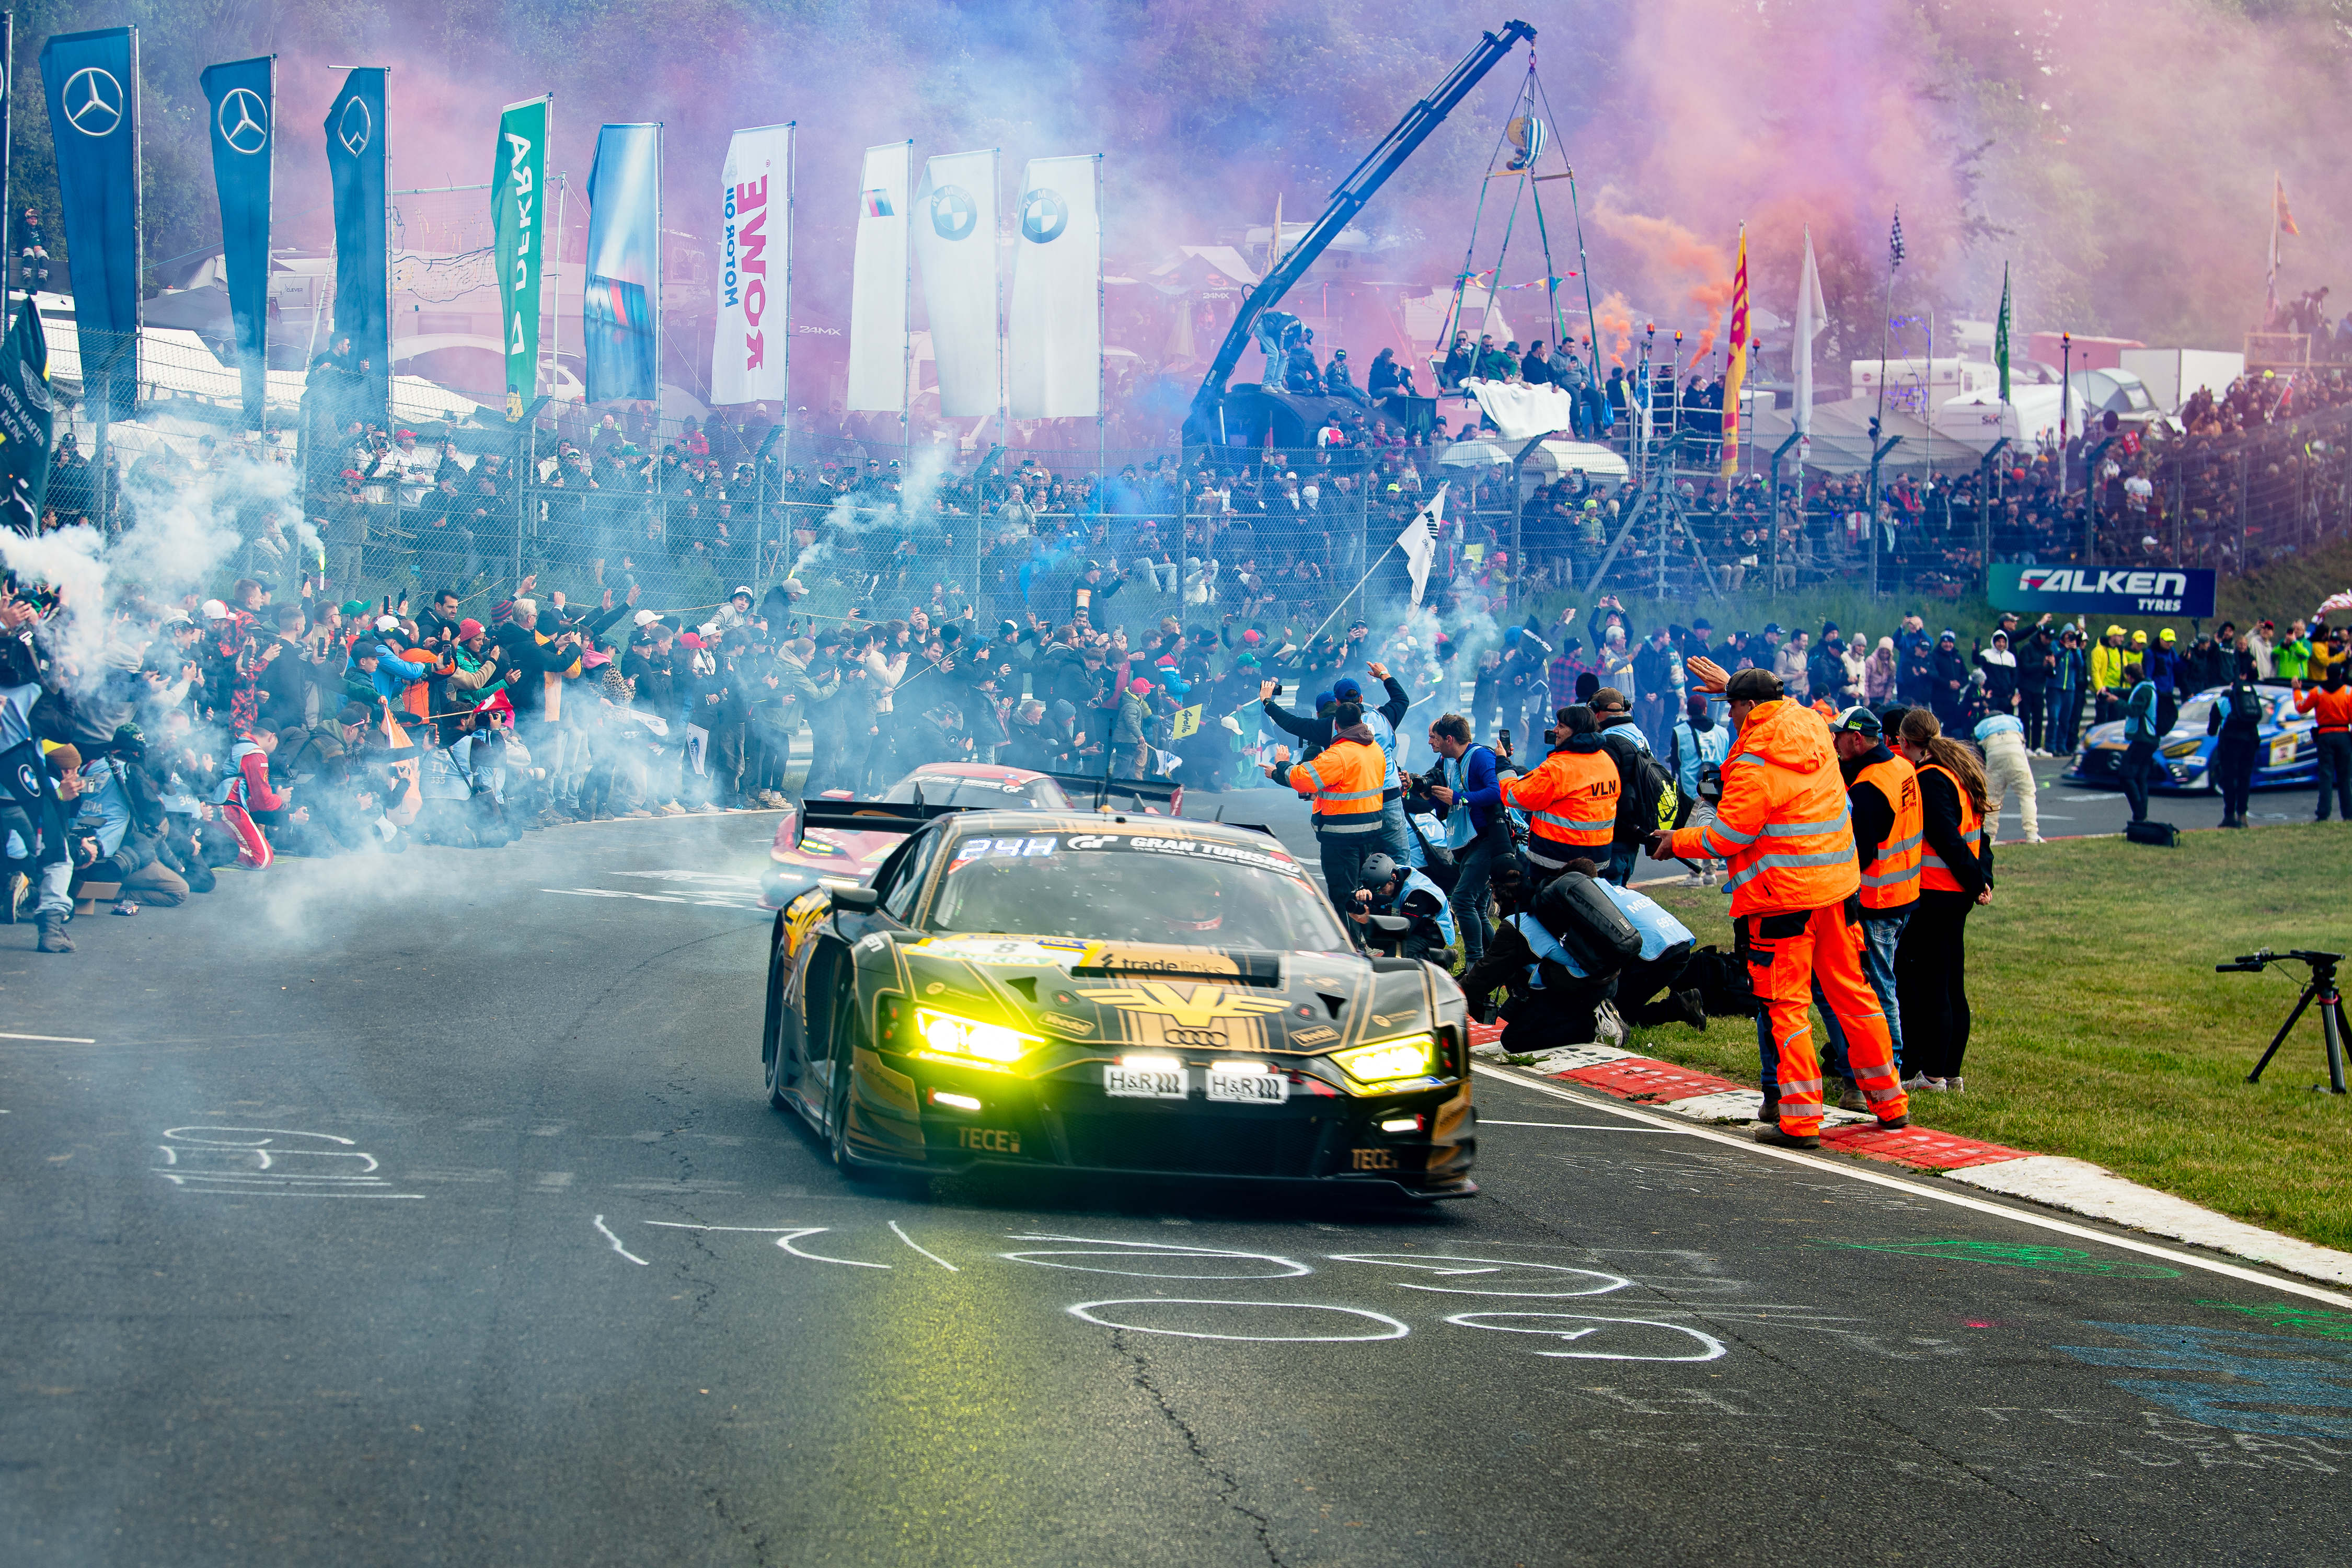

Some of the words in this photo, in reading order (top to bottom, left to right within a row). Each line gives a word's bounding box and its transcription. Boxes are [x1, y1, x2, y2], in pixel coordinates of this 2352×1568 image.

[799, 325, 841, 336] 24MX
[1, 383, 22, 413] ASTON
[18, 410, 45, 447] MARTIN
[1, 409, 26, 444] RACING
[2019, 569, 2187, 596] FALKEN
[2138, 598, 2181, 612] TYRES
[431, 760, 448, 774] TV
[1590, 780, 1616, 797] VLN
[82, 800, 103, 814] EDIA
[957, 837, 1057, 861] 24H
[1130, 837, 1197, 852] GRAN
[1201, 843, 1301, 874] TURISMO
[1656, 916, 1674, 929] 693
[993, 943, 1020, 954] 8
[1110, 1070, 1152, 1092] H&R
[1212, 1075, 1254, 1095] H&R
[958, 1126, 1009, 1152] TECE
[1351, 1148, 1393, 1169] TECE
